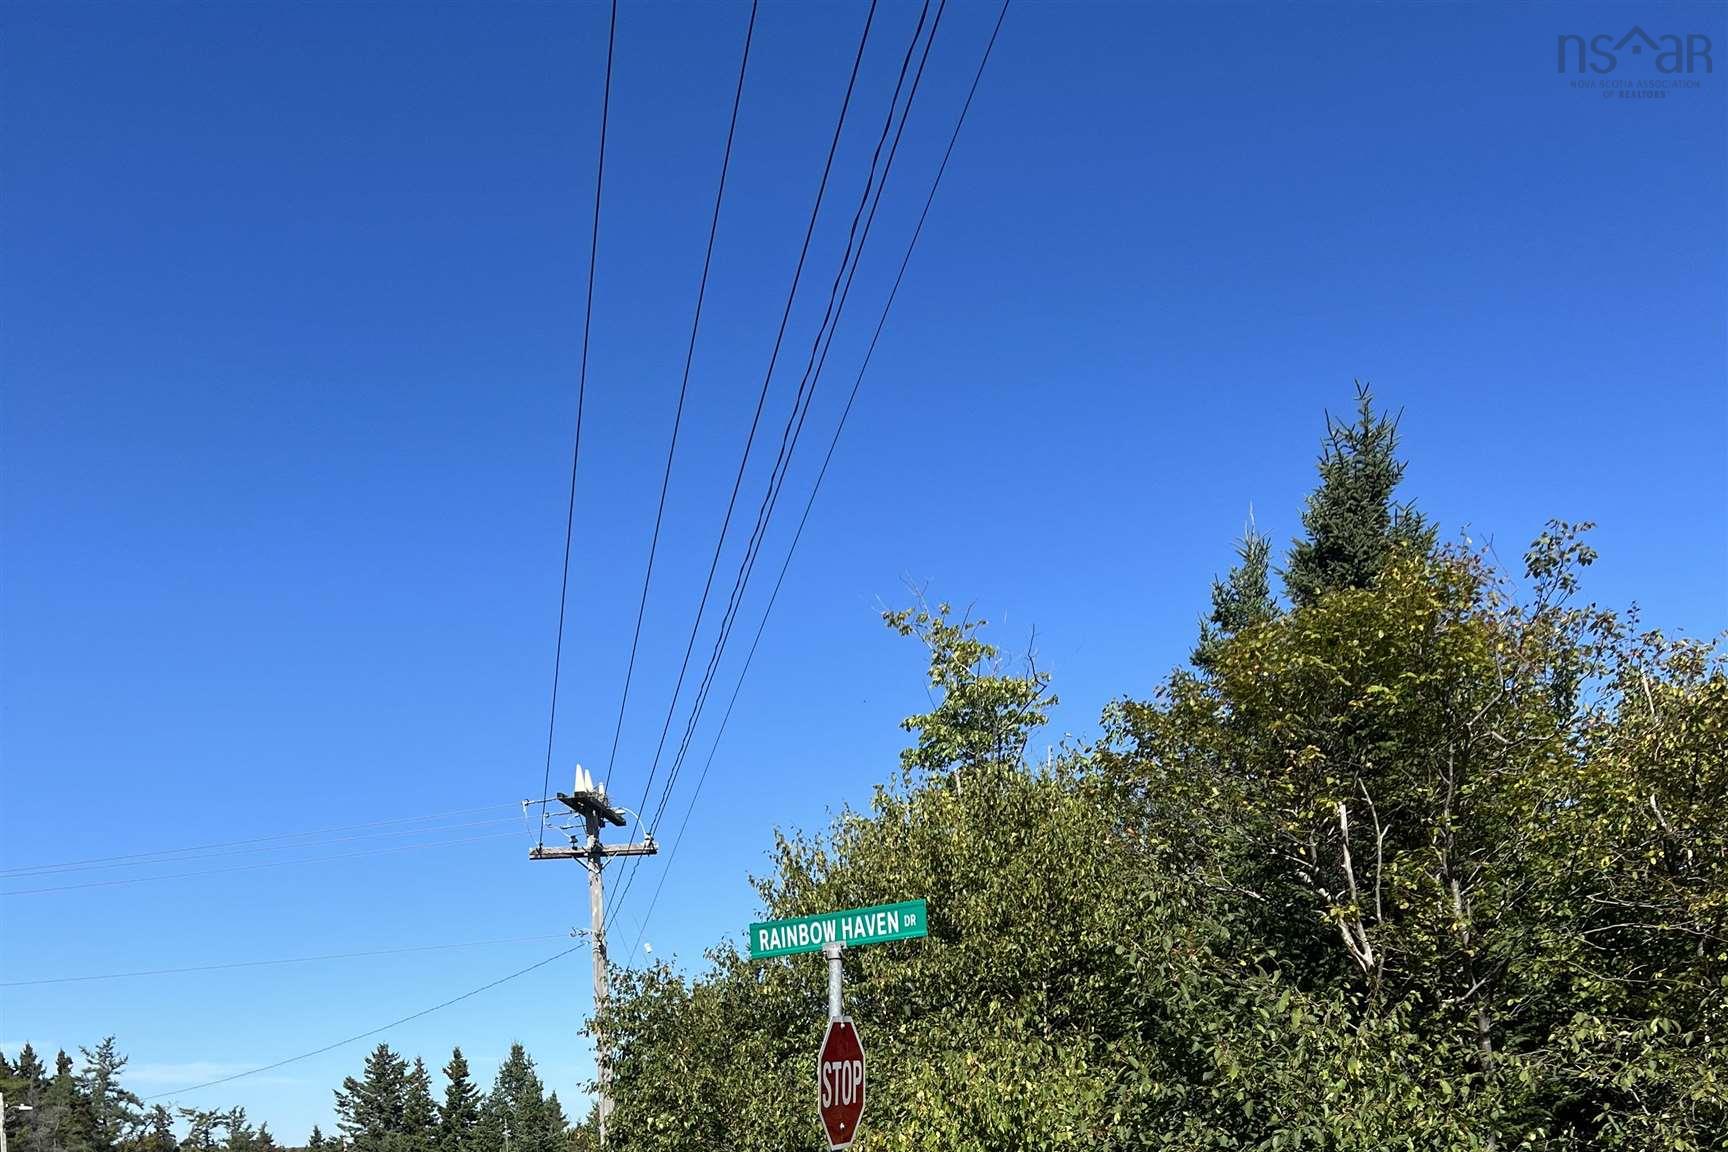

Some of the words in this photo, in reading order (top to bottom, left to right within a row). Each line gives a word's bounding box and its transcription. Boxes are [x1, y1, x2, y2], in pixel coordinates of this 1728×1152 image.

[759, 919, 836, 950] RAINBOW
[841, 911, 899, 940] HAVEN
[904, 914, 917, 927] DR
[822, 1060, 862, 1108] STOP
